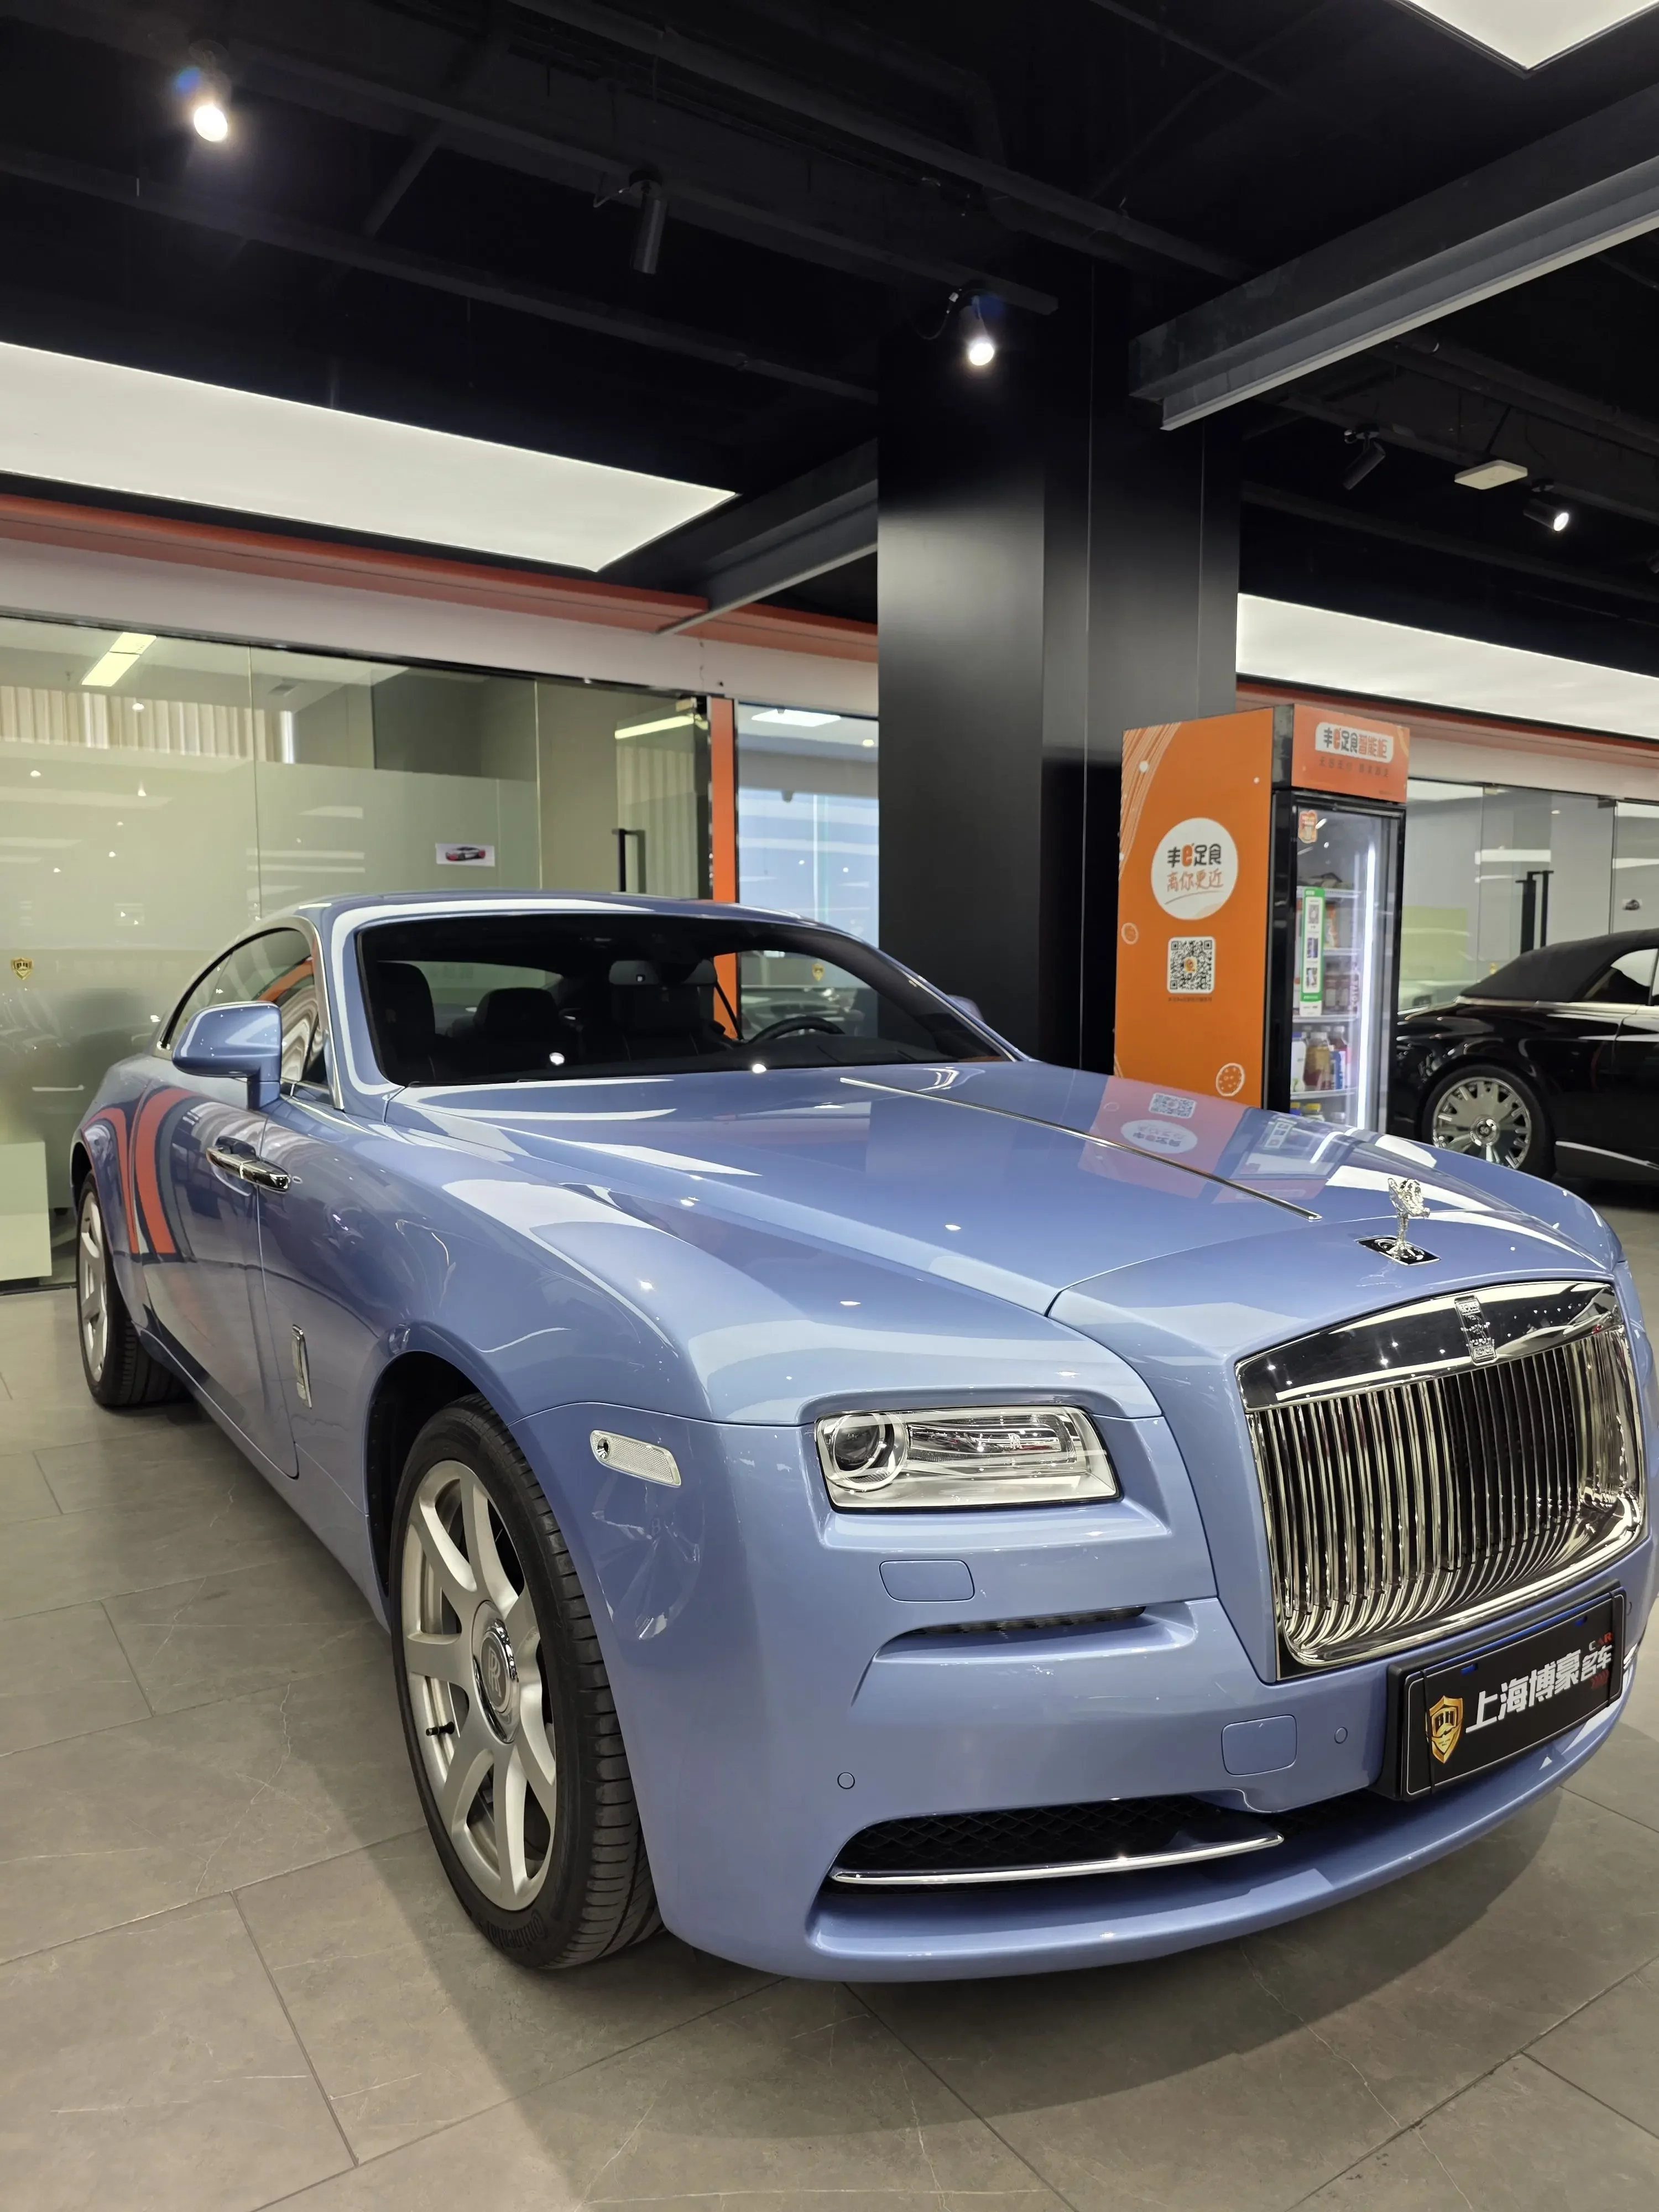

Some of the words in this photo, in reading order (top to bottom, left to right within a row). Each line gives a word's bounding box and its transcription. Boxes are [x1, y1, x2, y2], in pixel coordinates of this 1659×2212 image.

[1167, 868, 1224, 892] 离你更近
[1589, 1632, 1613, 1651] CAR
